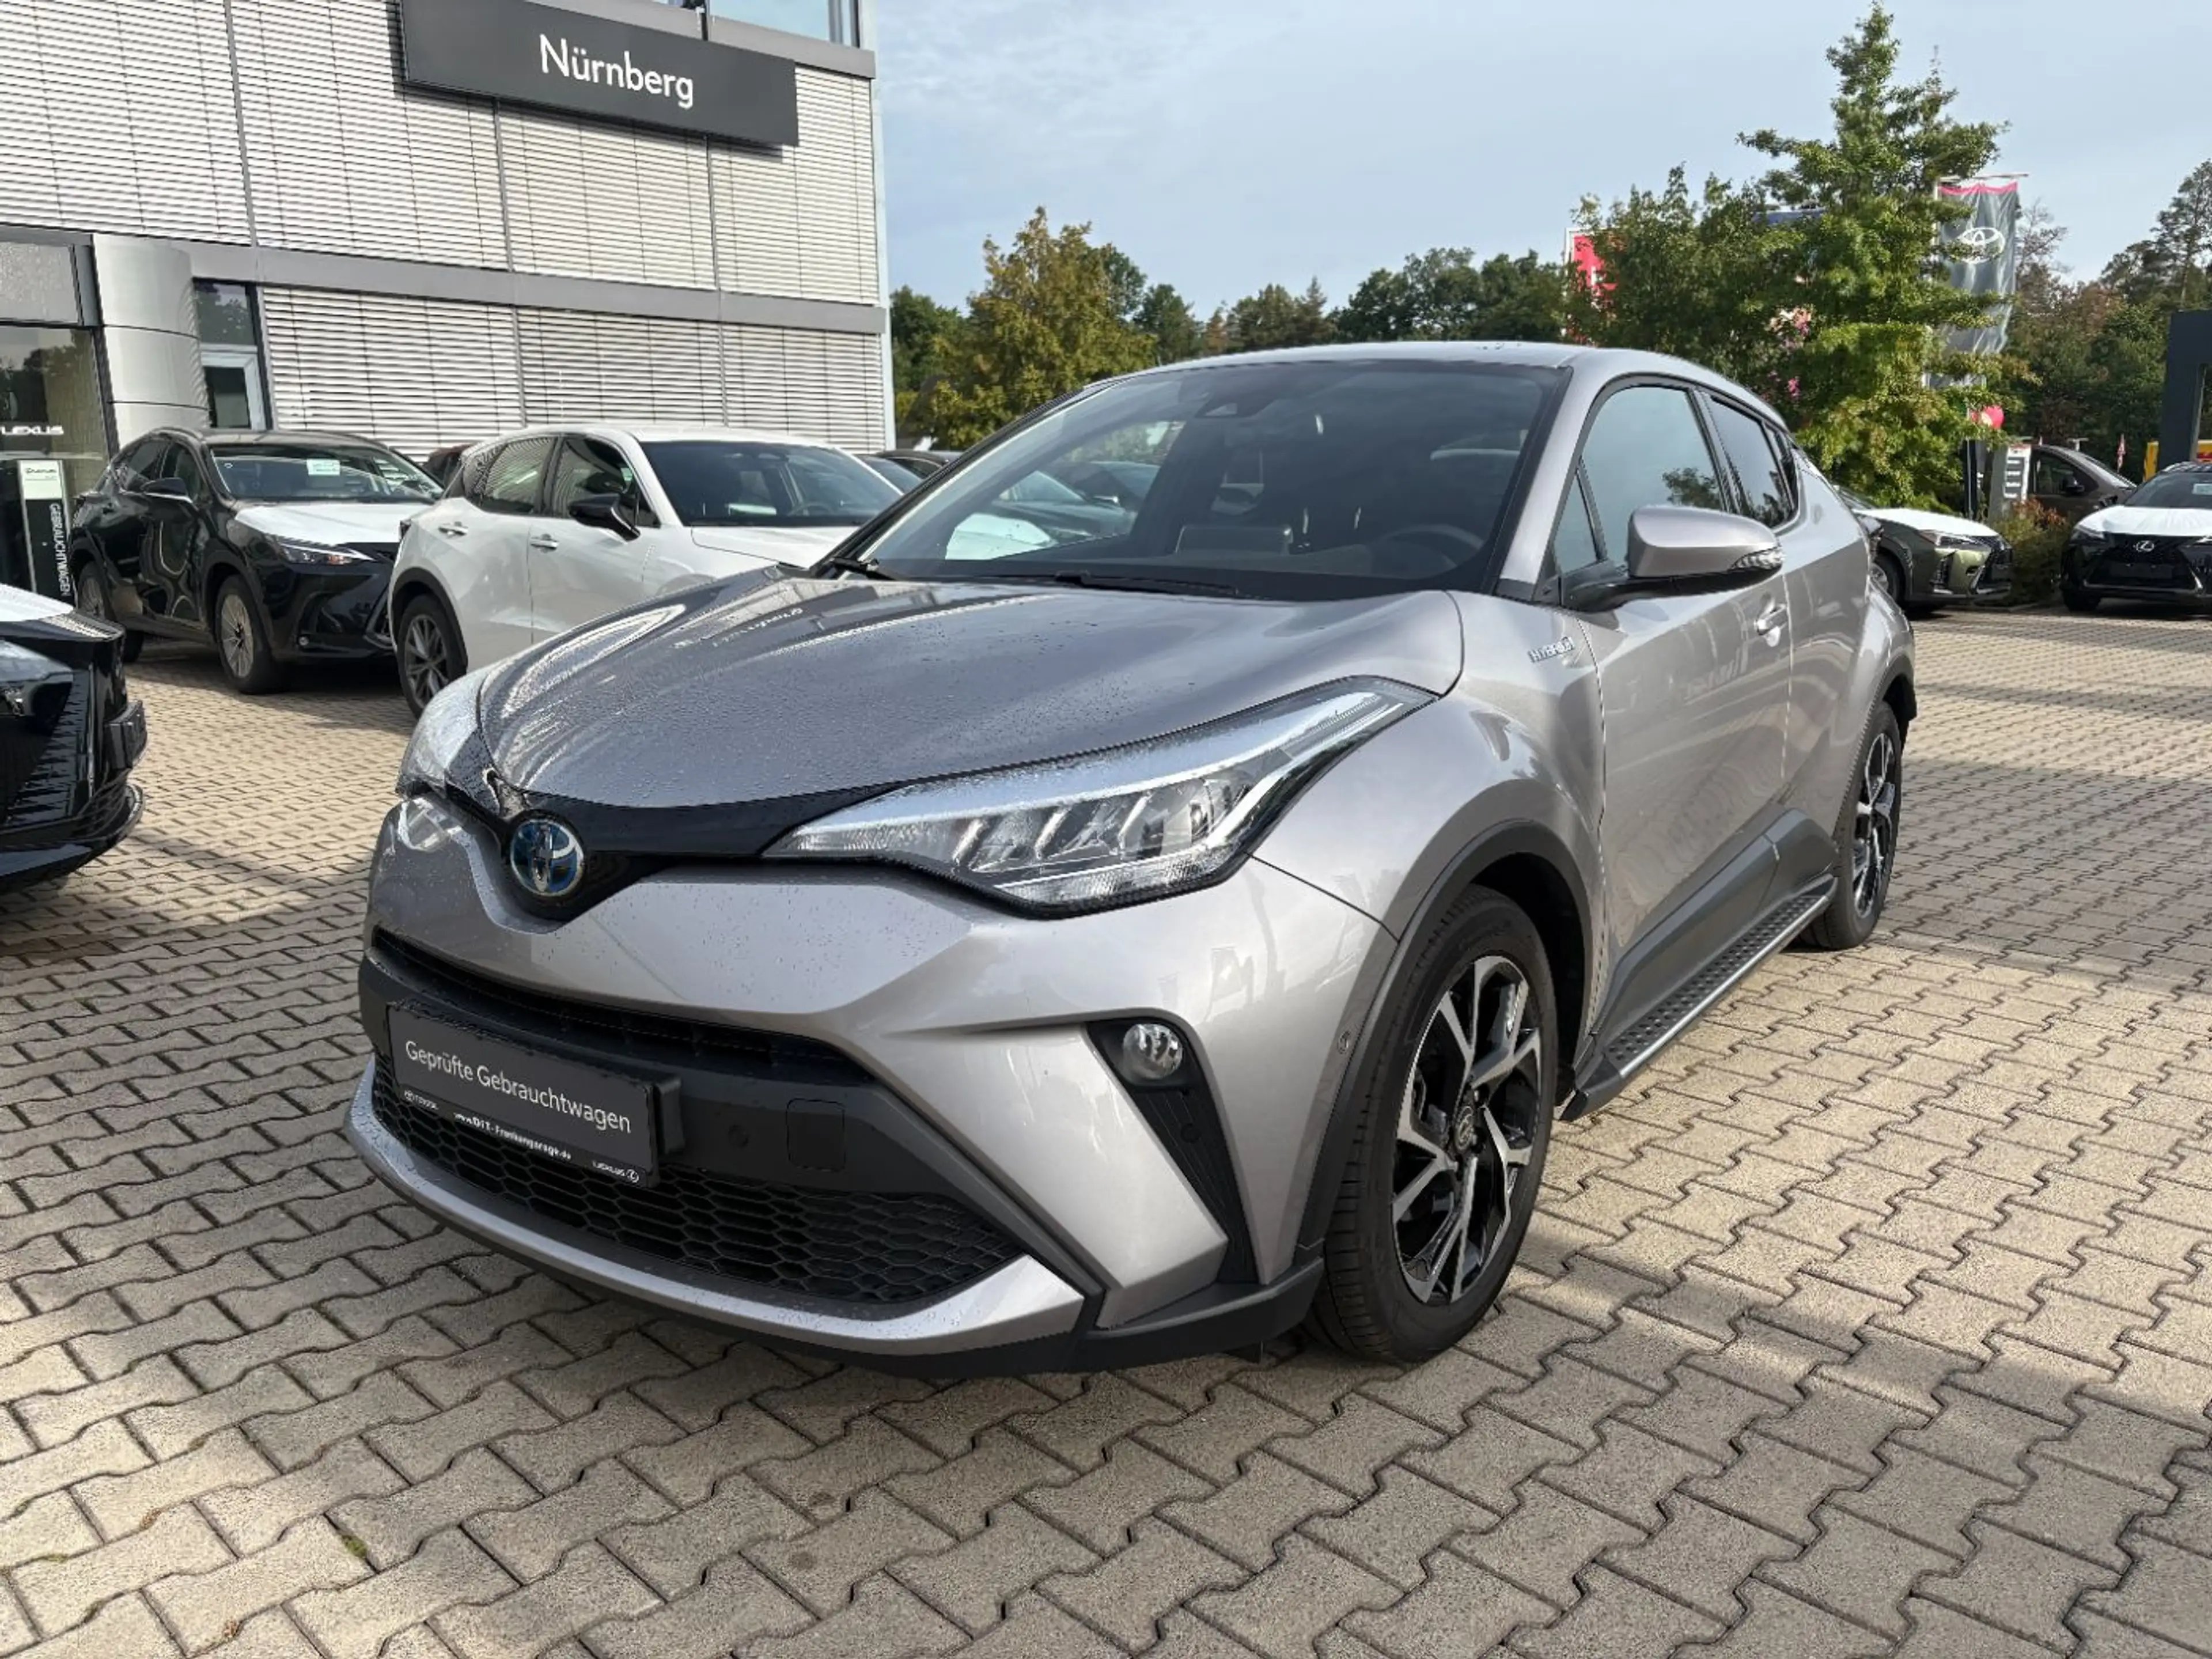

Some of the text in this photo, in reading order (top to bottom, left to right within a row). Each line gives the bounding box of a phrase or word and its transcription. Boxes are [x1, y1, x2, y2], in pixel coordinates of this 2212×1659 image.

[539, 33, 694, 110] Nürnberg
[406, 1040, 632, 1134] Geprüfte Gebrauchtwagen
